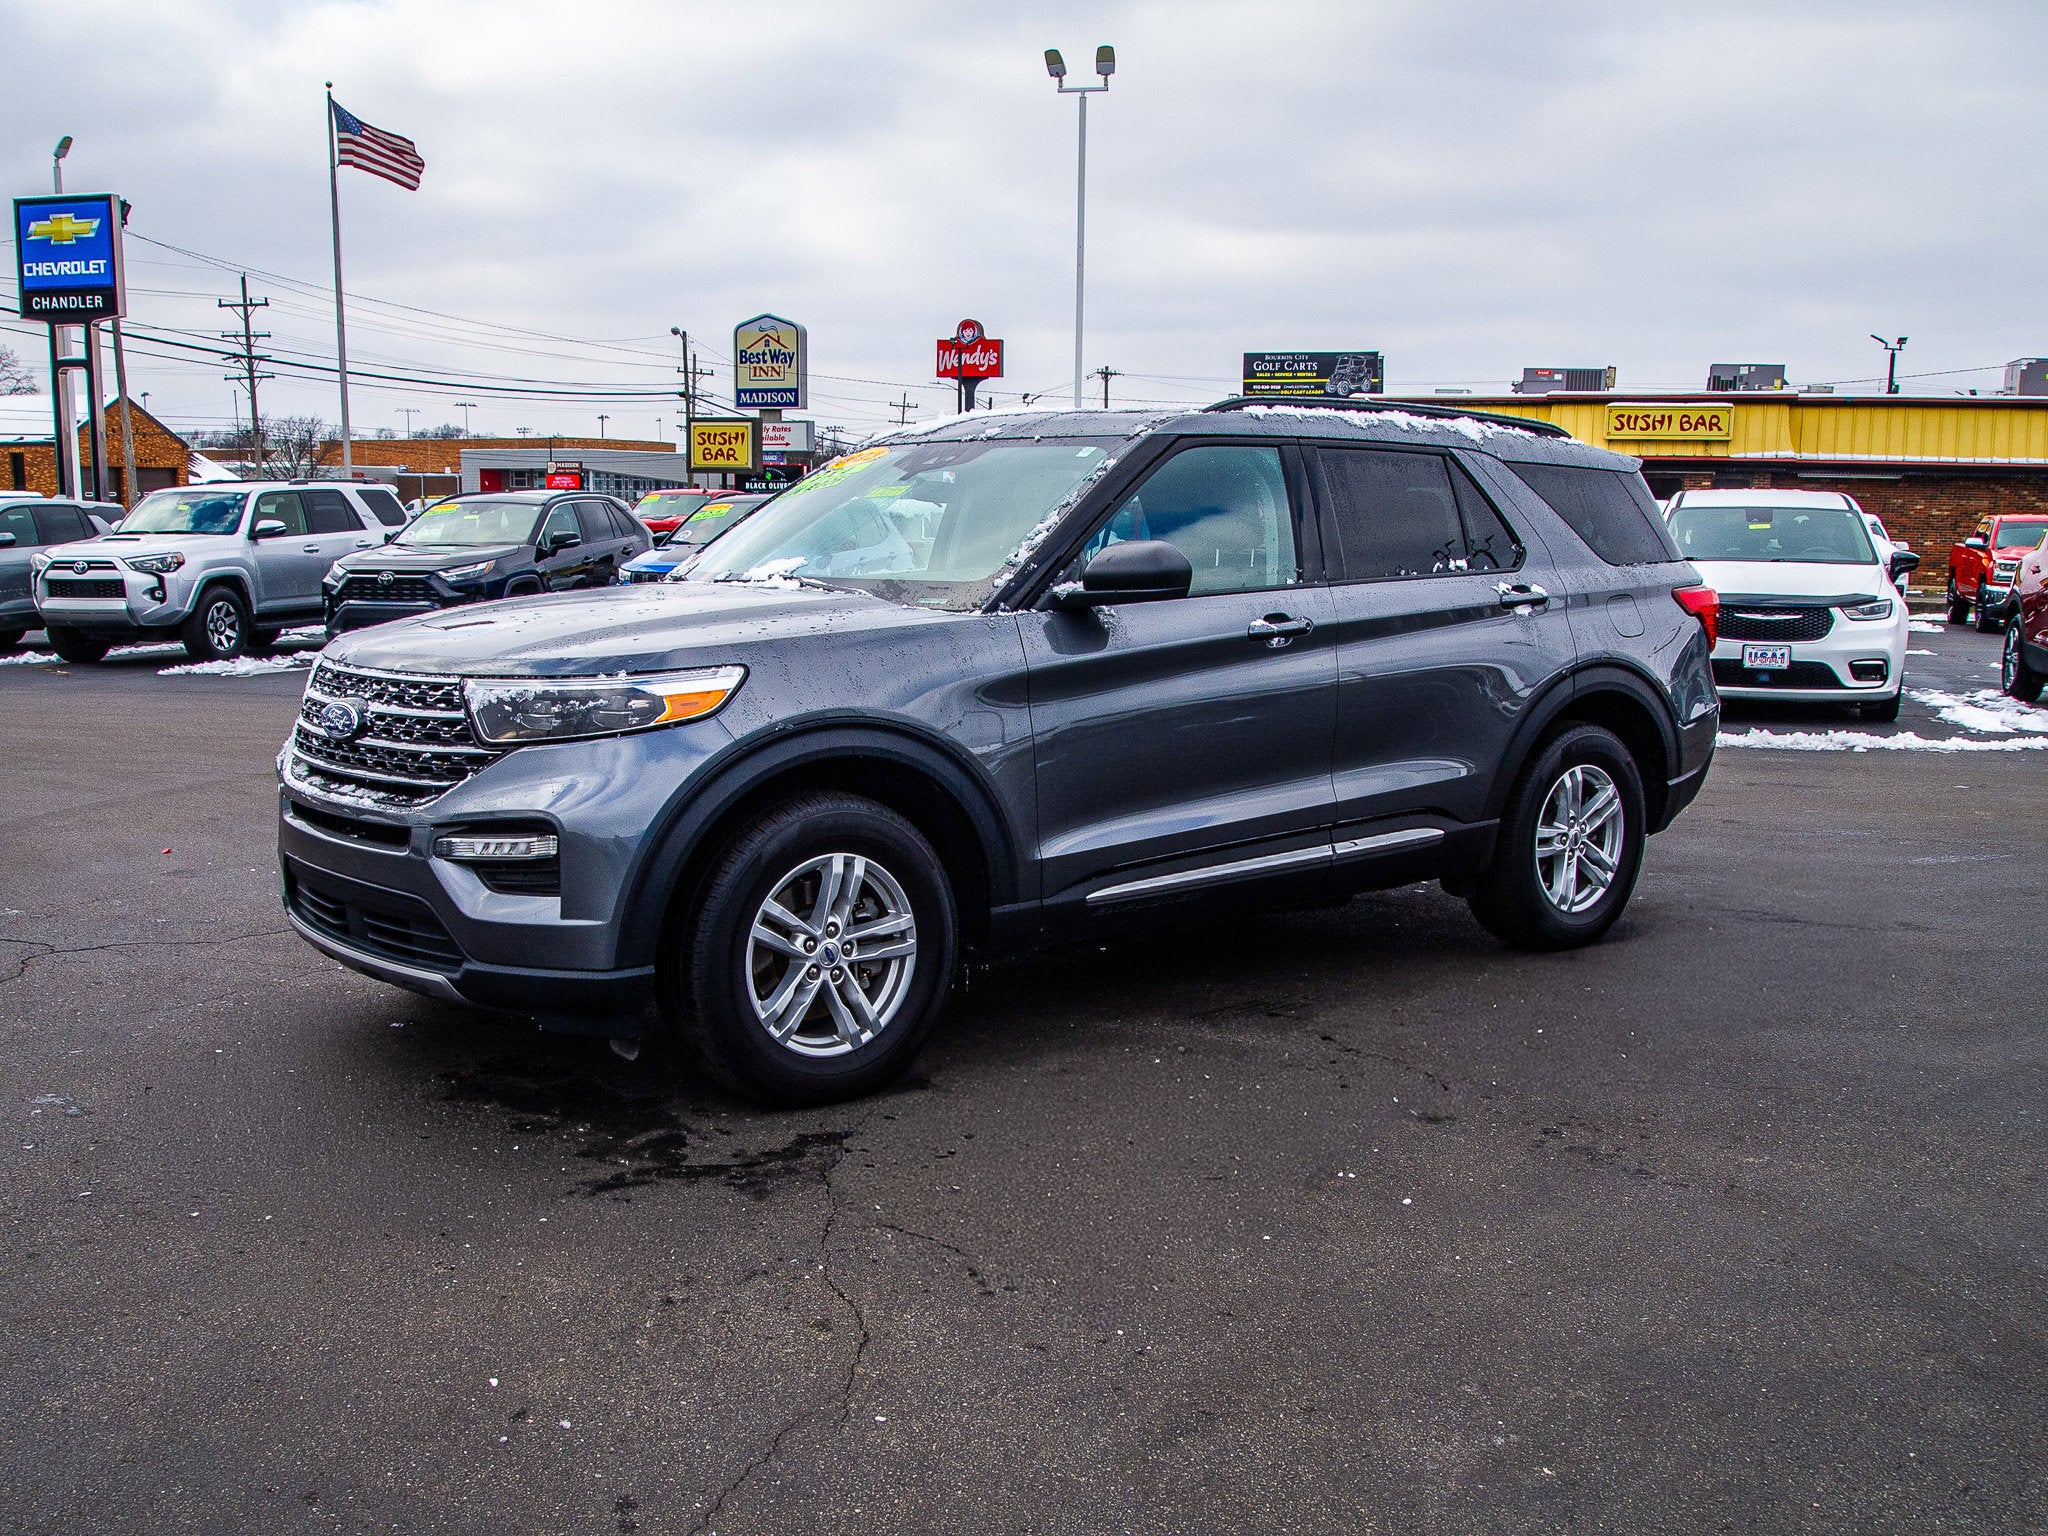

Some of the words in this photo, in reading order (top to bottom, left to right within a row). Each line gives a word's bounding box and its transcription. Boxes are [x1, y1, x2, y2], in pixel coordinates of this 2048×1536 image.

[23, 259, 107, 277] CHEVROLET
[32, 295, 103, 310] CHANDLER
[739, 349, 767, 364] Best
[768, 348, 795, 369] Way
[938, 344, 998, 372] Wendy's
[1253, 360, 1281, 371] GOLF
[1284, 360, 1318, 371] CARTS
[751, 365, 782, 378] INN
[740, 392, 796, 404] MADISON
[771, 425, 792, 433] Rates
[1613, 413, 1673, 432] SUSHI
[1679, 413, 1724, 432] BAR
[696, 431, 746, 446] SUSHI
[701, 447, 739, 461] BAR
